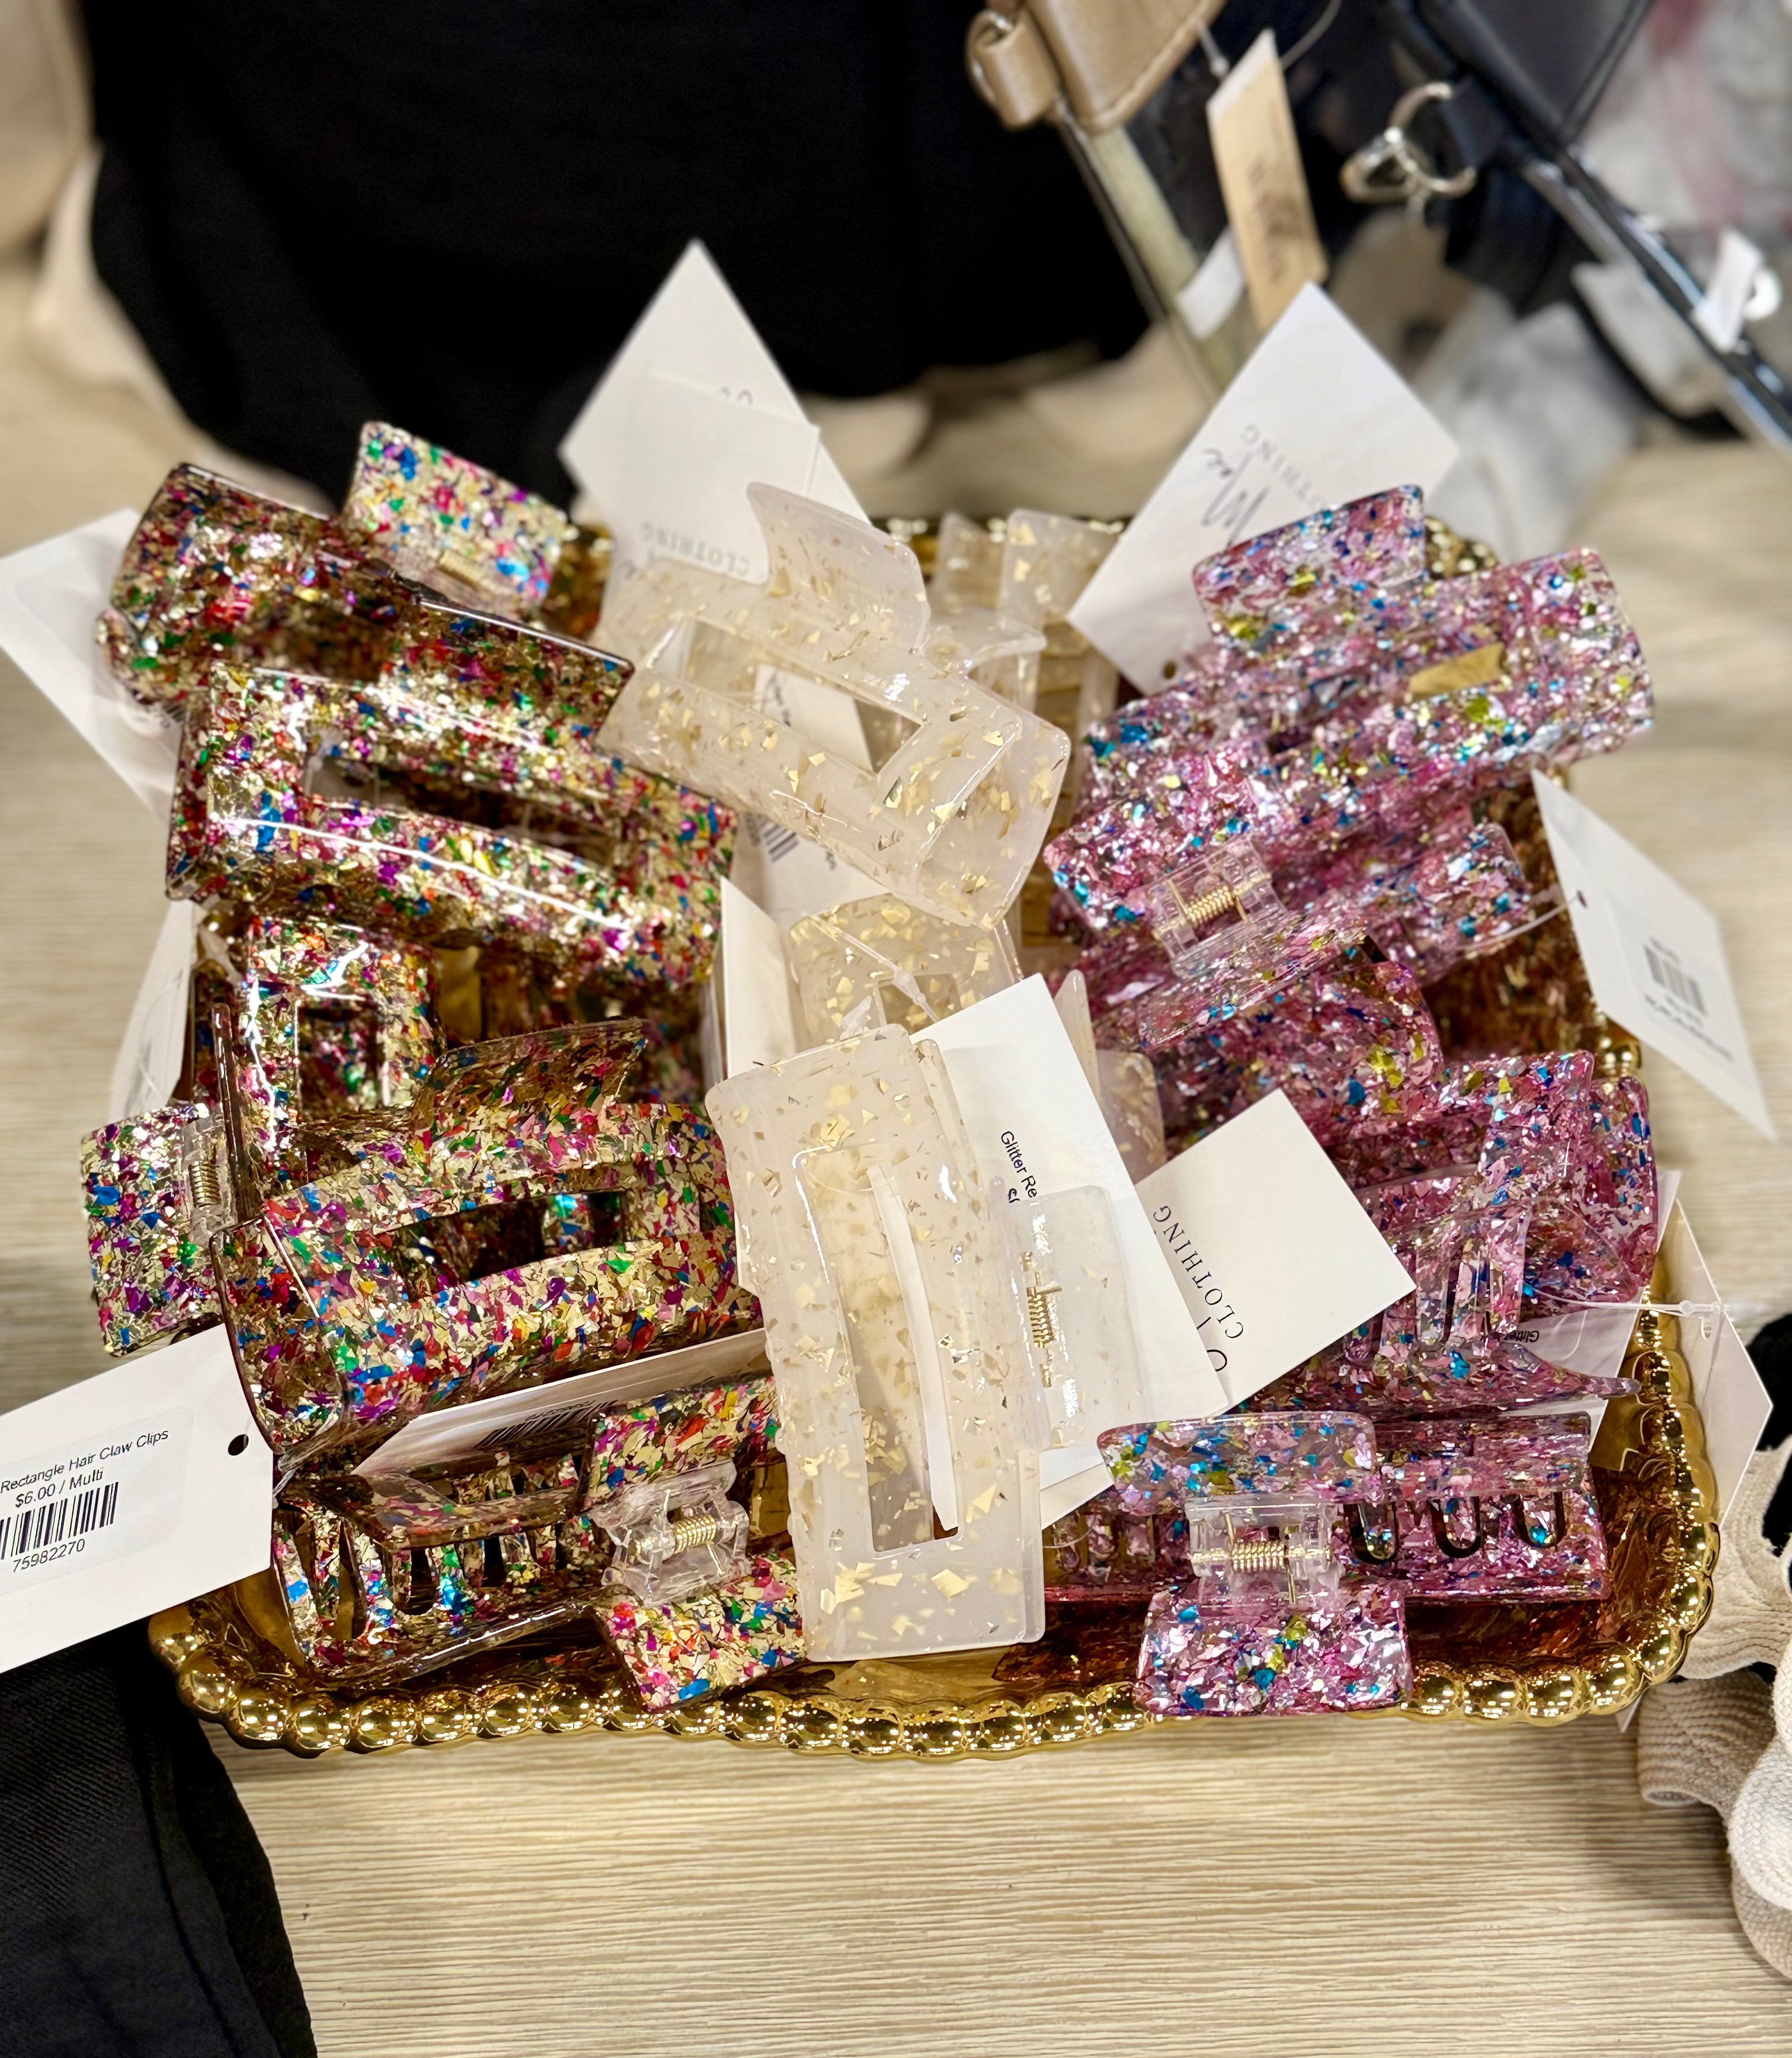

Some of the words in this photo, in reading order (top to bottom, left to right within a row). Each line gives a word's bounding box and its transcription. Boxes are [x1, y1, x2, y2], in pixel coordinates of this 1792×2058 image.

[1000, 1131, 1027, 1173] Glitter
[1153, 1205, 1244, 1340] CLOTHING
[0, 1464, 65, 1493] Rectangle
[69, 1453, 96, 1471] Hair
[100, 1441, 133, 1460] Claw
[136, 1429, 169, 1448] Clips
[15, 1483, 56, 1508] $6.00
[59, 1480, 66, 1494] /
[69, 1467, 104, 1490] Multi
[13, 1538, 85, 1573] 75982270
